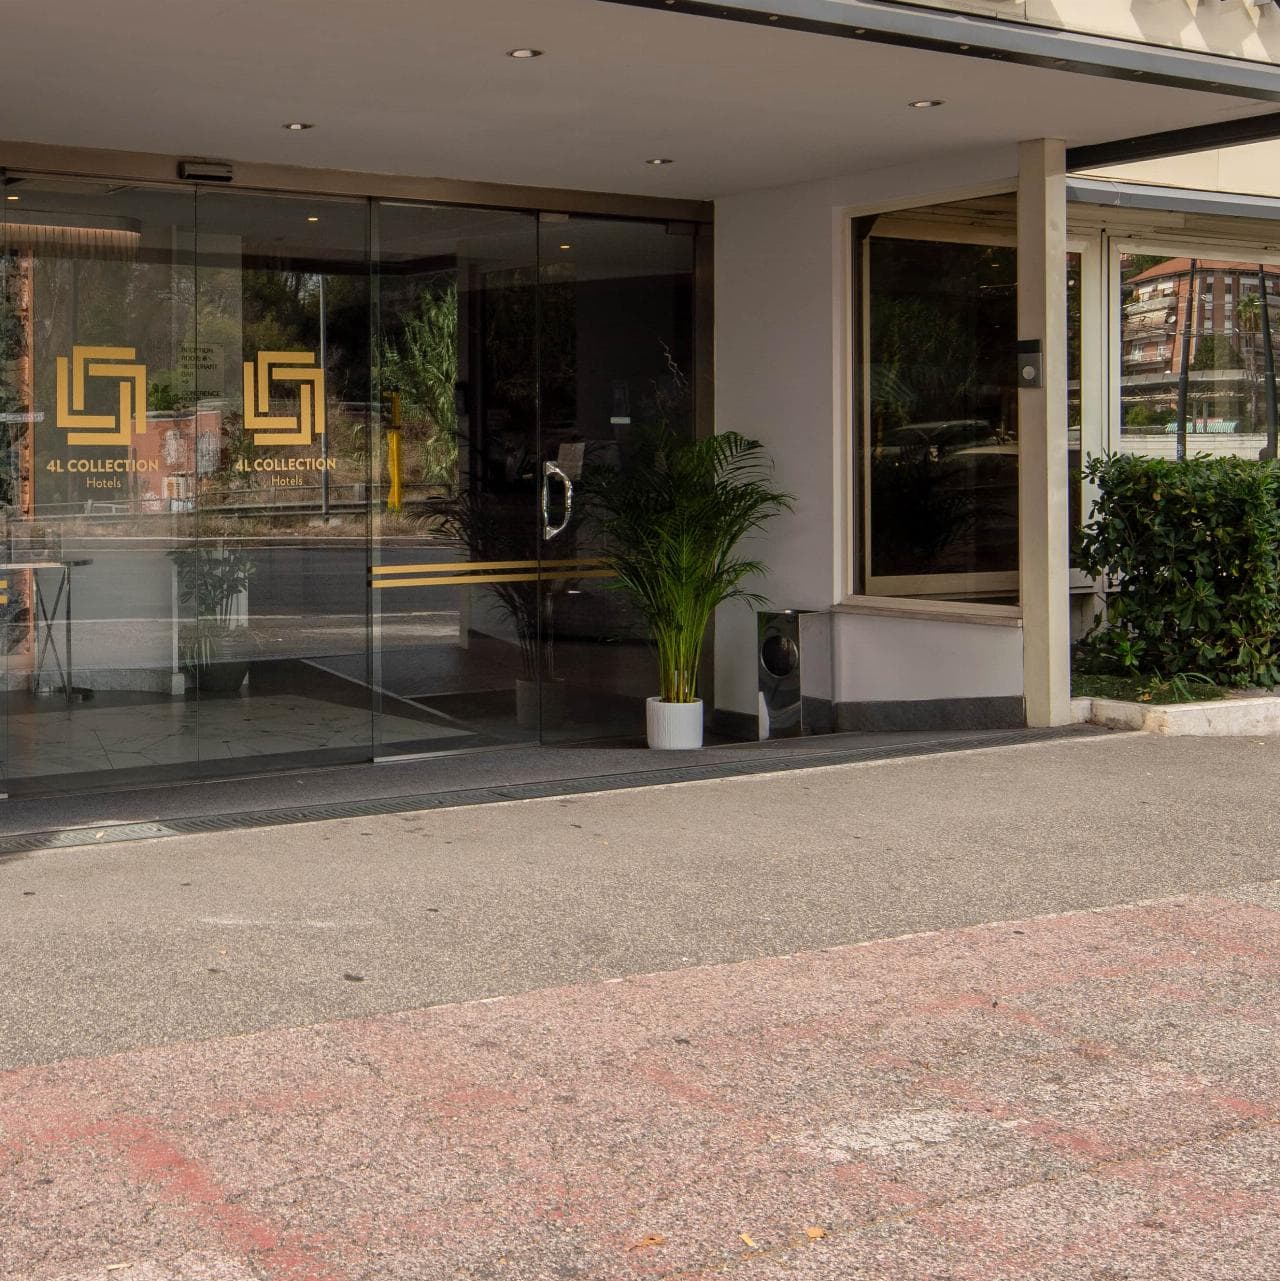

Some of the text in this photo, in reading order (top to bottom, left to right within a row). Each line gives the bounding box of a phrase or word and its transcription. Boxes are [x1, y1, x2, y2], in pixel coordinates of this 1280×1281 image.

[46, 459, 159, 473] 4L COLLECTION
[235, 458, 337, 472] 4L COLLECTION
[86, 476, 122, 489] Hotels
[271, 474, 303, 487] Hotels
